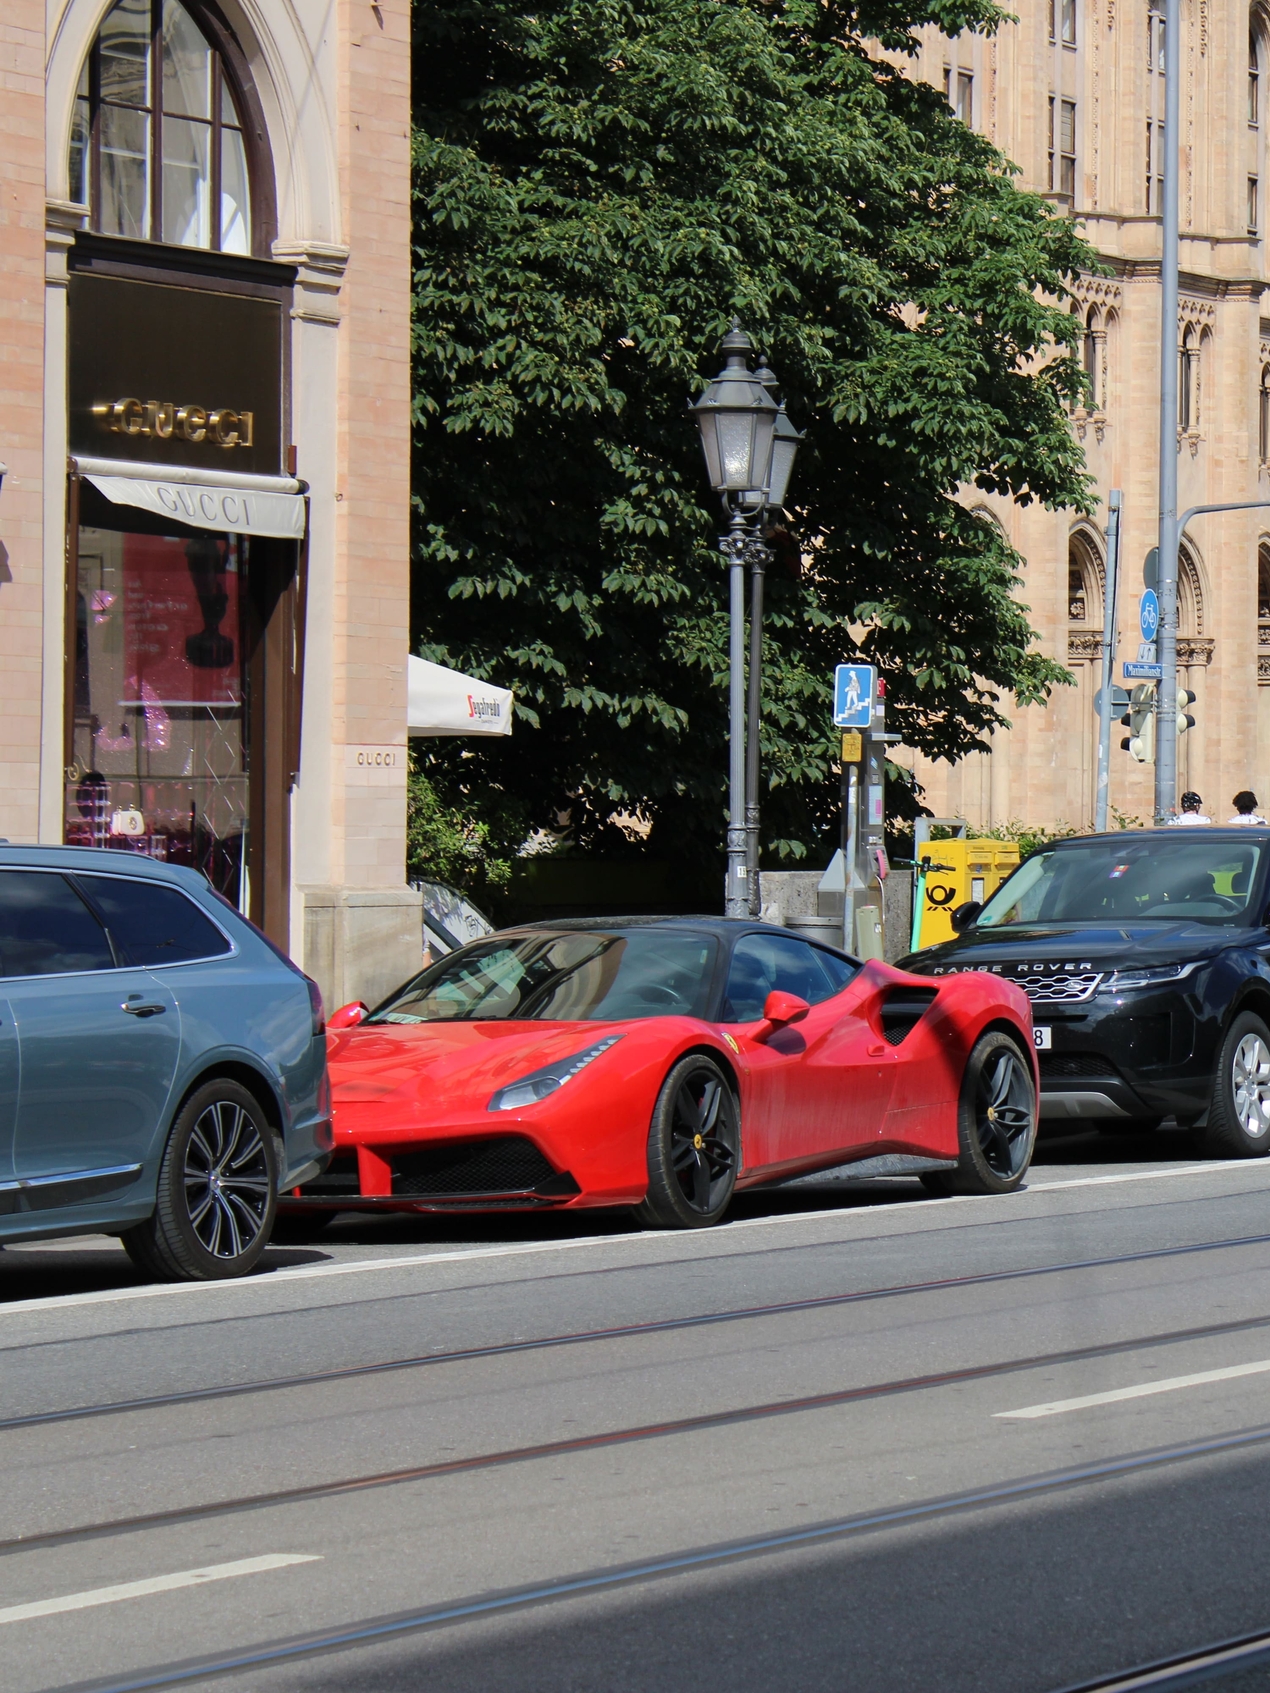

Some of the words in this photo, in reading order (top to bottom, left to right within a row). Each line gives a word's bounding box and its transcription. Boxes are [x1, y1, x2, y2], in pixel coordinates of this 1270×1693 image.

[113, 397, 253, 447] GUCCI
[156, 487, 251, 526] GUCCI
[357, 752, 396, 766] GUCCI
[933, 965, 1003, 974] RANGE
[1017, 962, 1092, 971] ROVER
